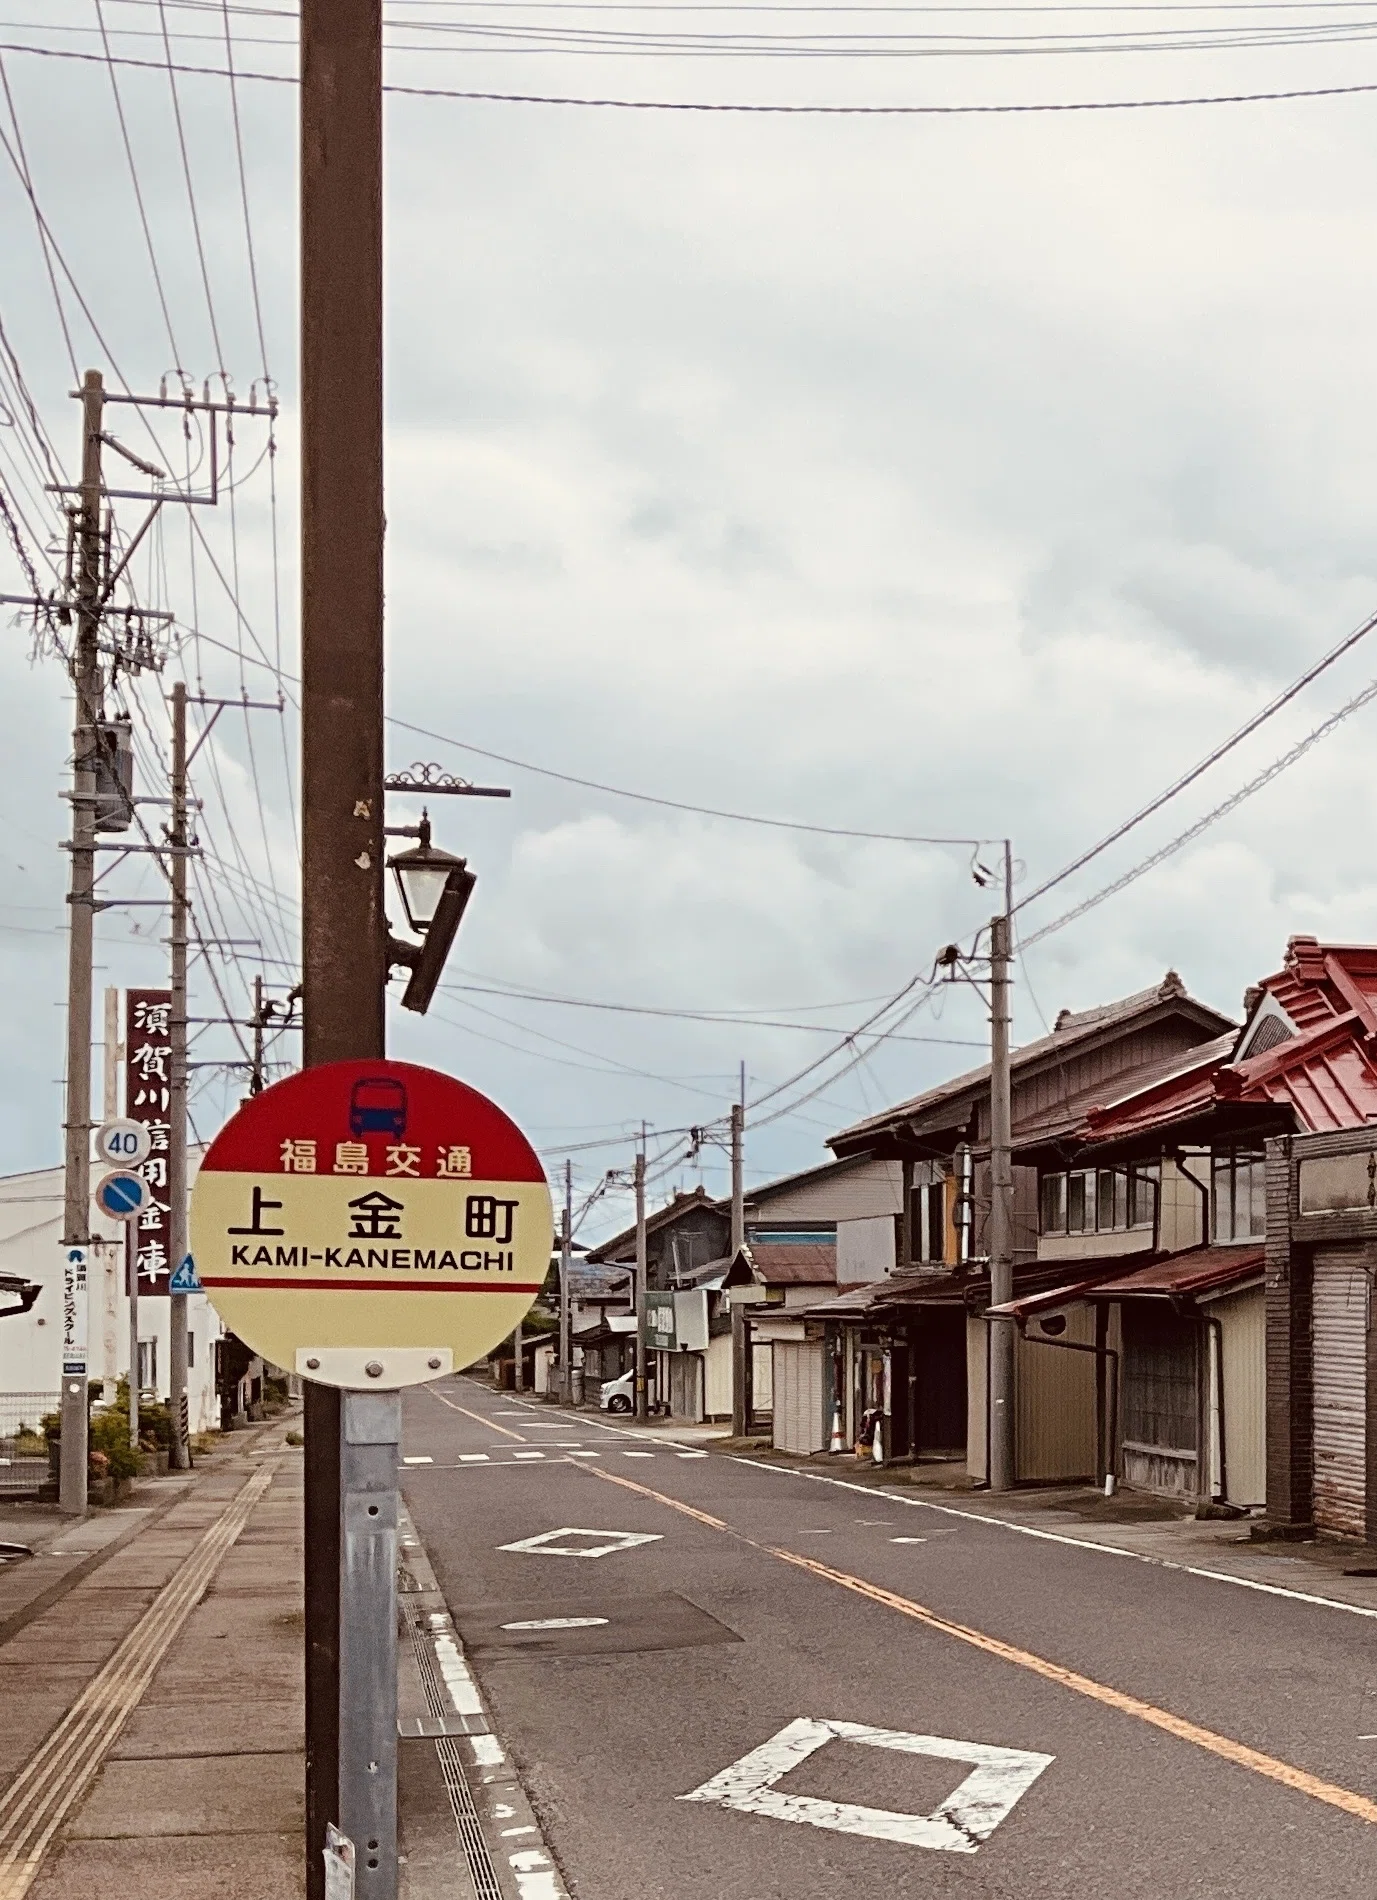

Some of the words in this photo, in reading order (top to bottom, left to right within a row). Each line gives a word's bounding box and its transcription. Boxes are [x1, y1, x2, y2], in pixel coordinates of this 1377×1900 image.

[108, 1132, 138, 1154] 40
[131, 1001, 172, 1284] 須賀川信用金庫
[279, 1138, 473, 1178] 福島交通
[227, 1186, 520, 1244] 上金町
[231, 1244, 514, 1272] KAMI-KANEMACHI
[64, 1268, 76, 1345] ドライビングスクール
